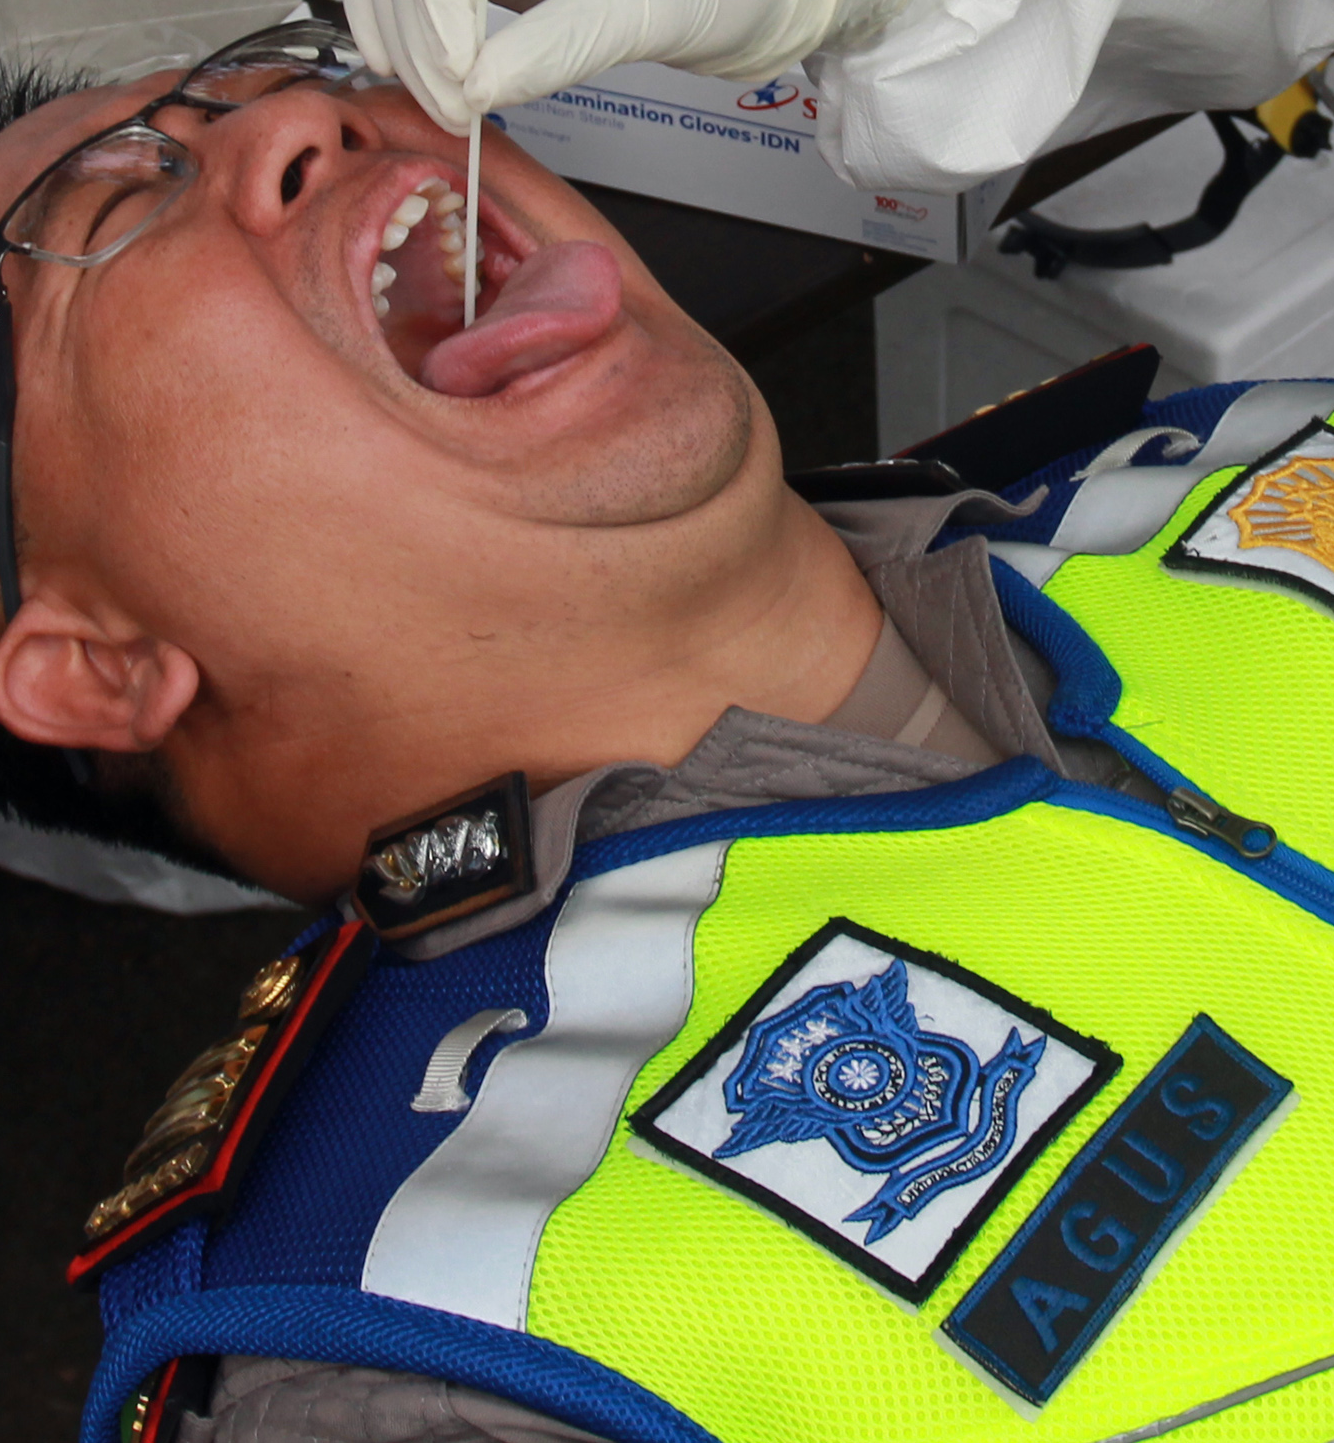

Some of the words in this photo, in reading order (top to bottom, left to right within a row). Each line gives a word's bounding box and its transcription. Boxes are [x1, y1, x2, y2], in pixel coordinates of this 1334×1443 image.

[546, 86, 674, 128] xamination
[678, 112, 801, 154] Gloves-IDN
[1008, 1073, 1236, 1353] AGUS
